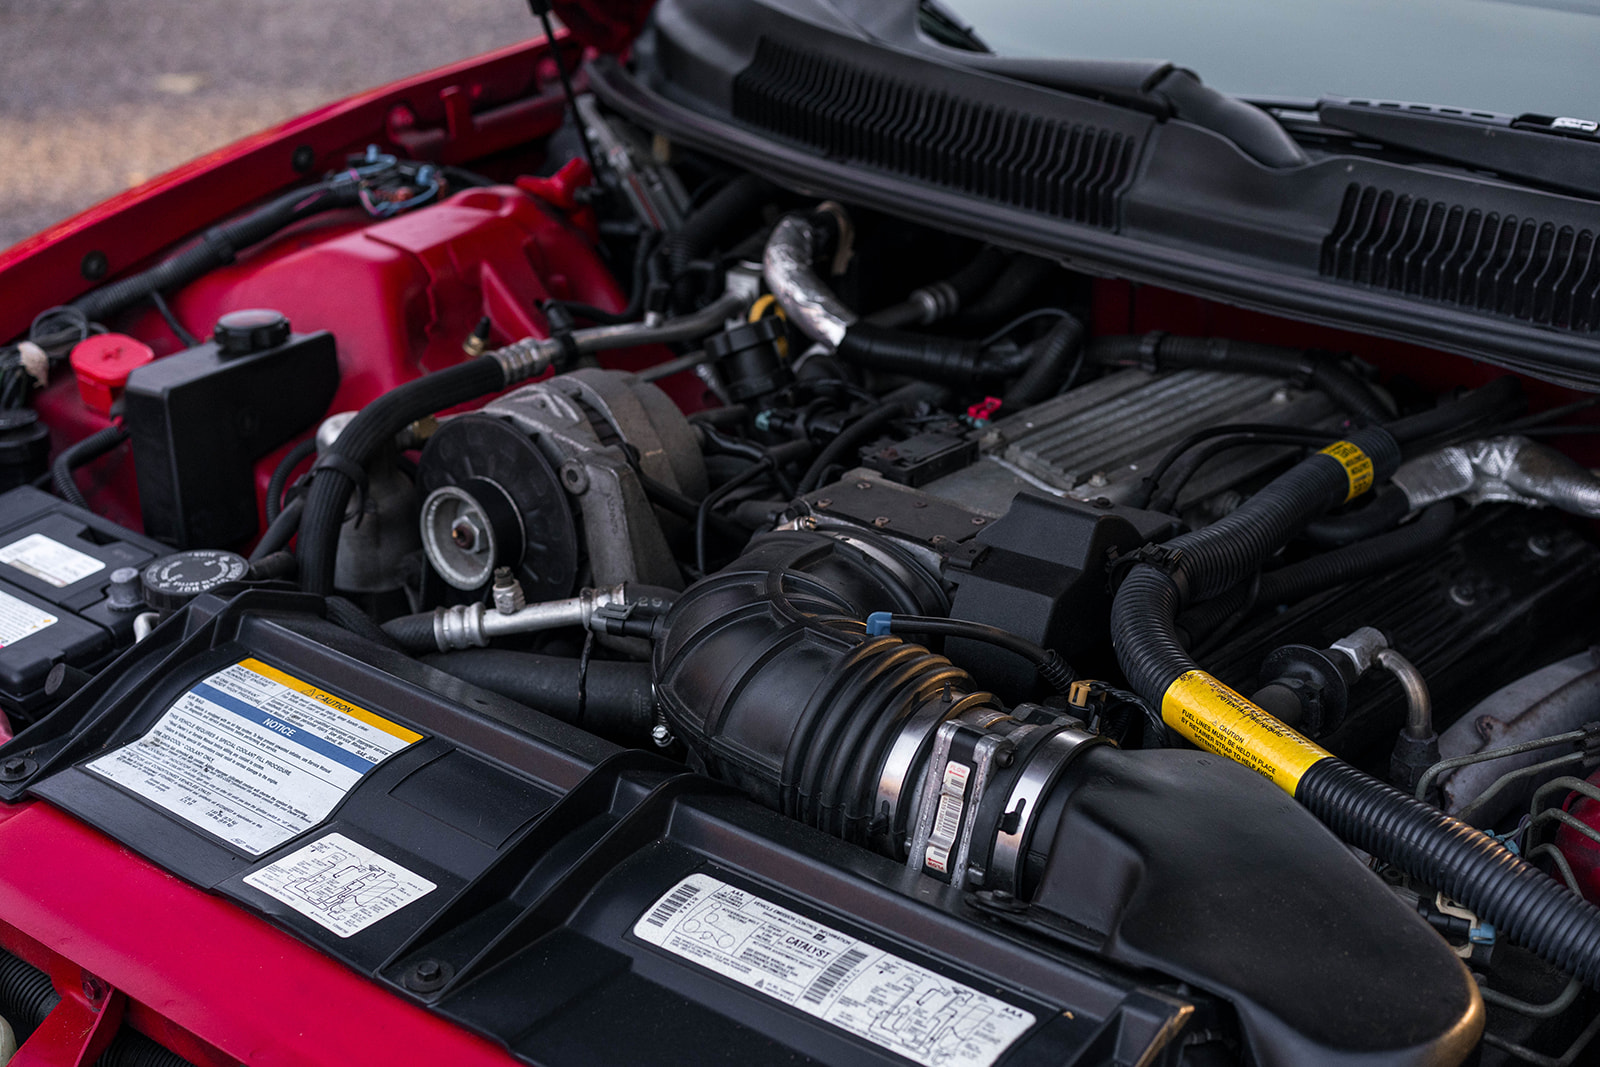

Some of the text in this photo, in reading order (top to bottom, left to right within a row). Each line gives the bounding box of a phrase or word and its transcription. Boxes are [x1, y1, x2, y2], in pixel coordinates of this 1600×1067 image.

[315, 693, 354, 713] CAUTION
[263, 718, 296, 737] NOTICE
[1219, 724, 1244, 743] CAUTION
[1181, 716, 1188, 725] BY
[1189, 722, 1215, 744] RETAINER
[1215, 739, 1233, 754] STRAP
[1233, 752, 1240, 760] TO
[1241, 757, 1256, 768] HELP
[1256, 768, 1274, 781] AVOID
[1182, 709, 1195, 721] FUEL
[1196, 718, 1211, 732] LINES
[1212, 729, 1227, 742] MUST
[1227, 739, 1235, 747] BE
[1236, 745, 1250, 758] HELD
[1251, 754, 1257, 762] IN
[1258, 759, 1276, 775] PLACE
[949, 764, 966, 774] FLOW
[927, 861, 944, 871] FLOW
[785, 936, 831, 958] CATALYST
